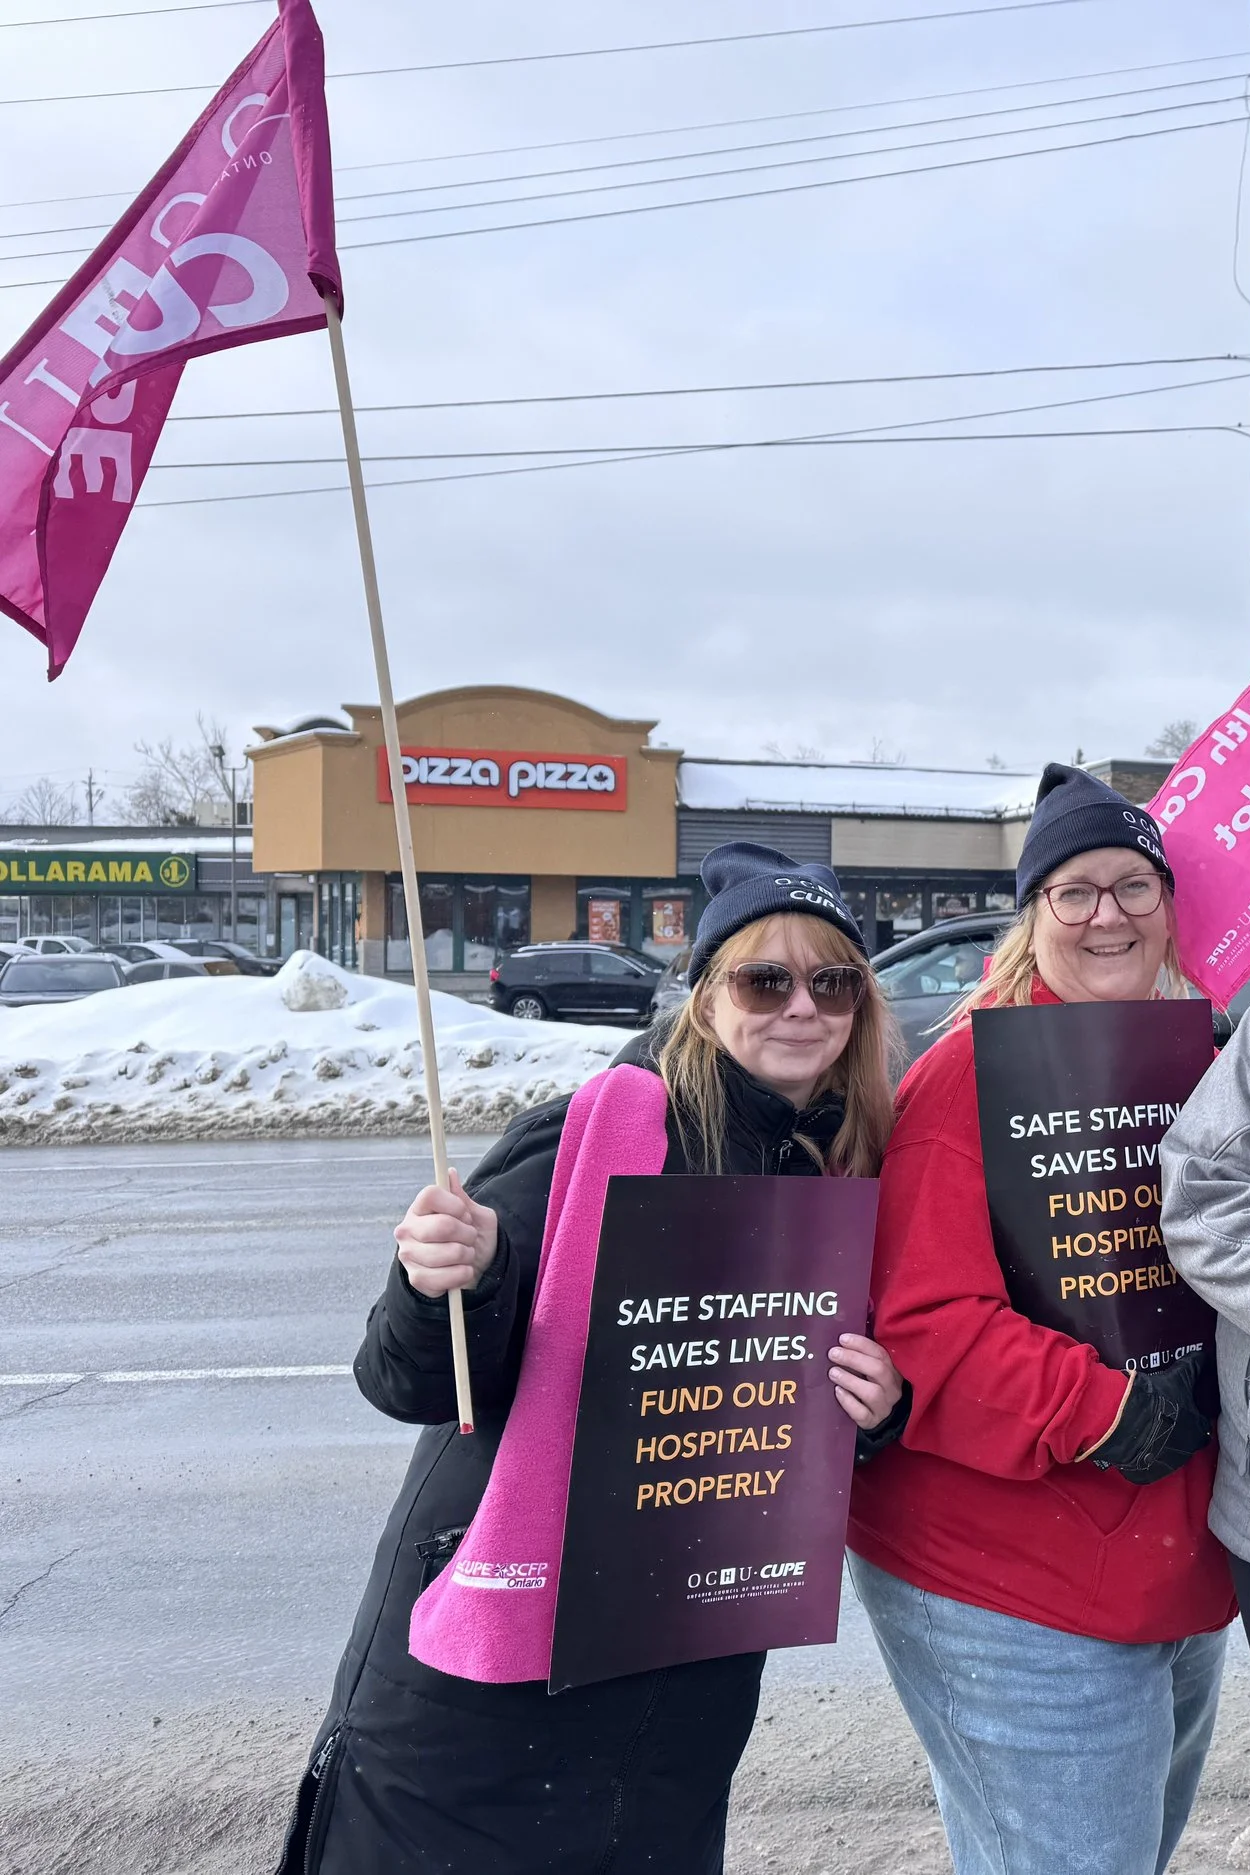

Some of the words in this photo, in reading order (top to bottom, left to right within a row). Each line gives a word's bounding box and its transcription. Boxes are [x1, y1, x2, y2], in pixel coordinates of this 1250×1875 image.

[508, 760, 615, 797] pizza
[789, 890, 847, 920] CUPE
[1009, 1110, 1081, 1139] SAFE
[1089, 1102, 1180, 1131] STAFFIN
[1030, 1147, 1117, 1178] SAVES
[1124, 1143, 1162, 1169] LIV
[1048, 1188, 1127, 1218] FUND
[1134, 1183, 1163, 1208] OU
[1051, 1224, 1167, 1259] HOSPITA
[1060, 1262, 1178, 1300] PROPERLY
[617, 1297, 689, 1326] SAFE
[698, 1291, 838, 1321] STAFFING
[630, 1339, 720, 1372] SAVES
[729, 1335, 814, 1363] LIVES.
[640, 1385, 723, 1417] FUND
[732, 1380, 797, 1407] OUR
[635, 1424, 793, 1464] HOSPITALS
[636, 1469, 785, 1511] PROPERLY
[506, 1562, 548, 1577] SCFP
[507, 1578, 543, 1588] Ontario
